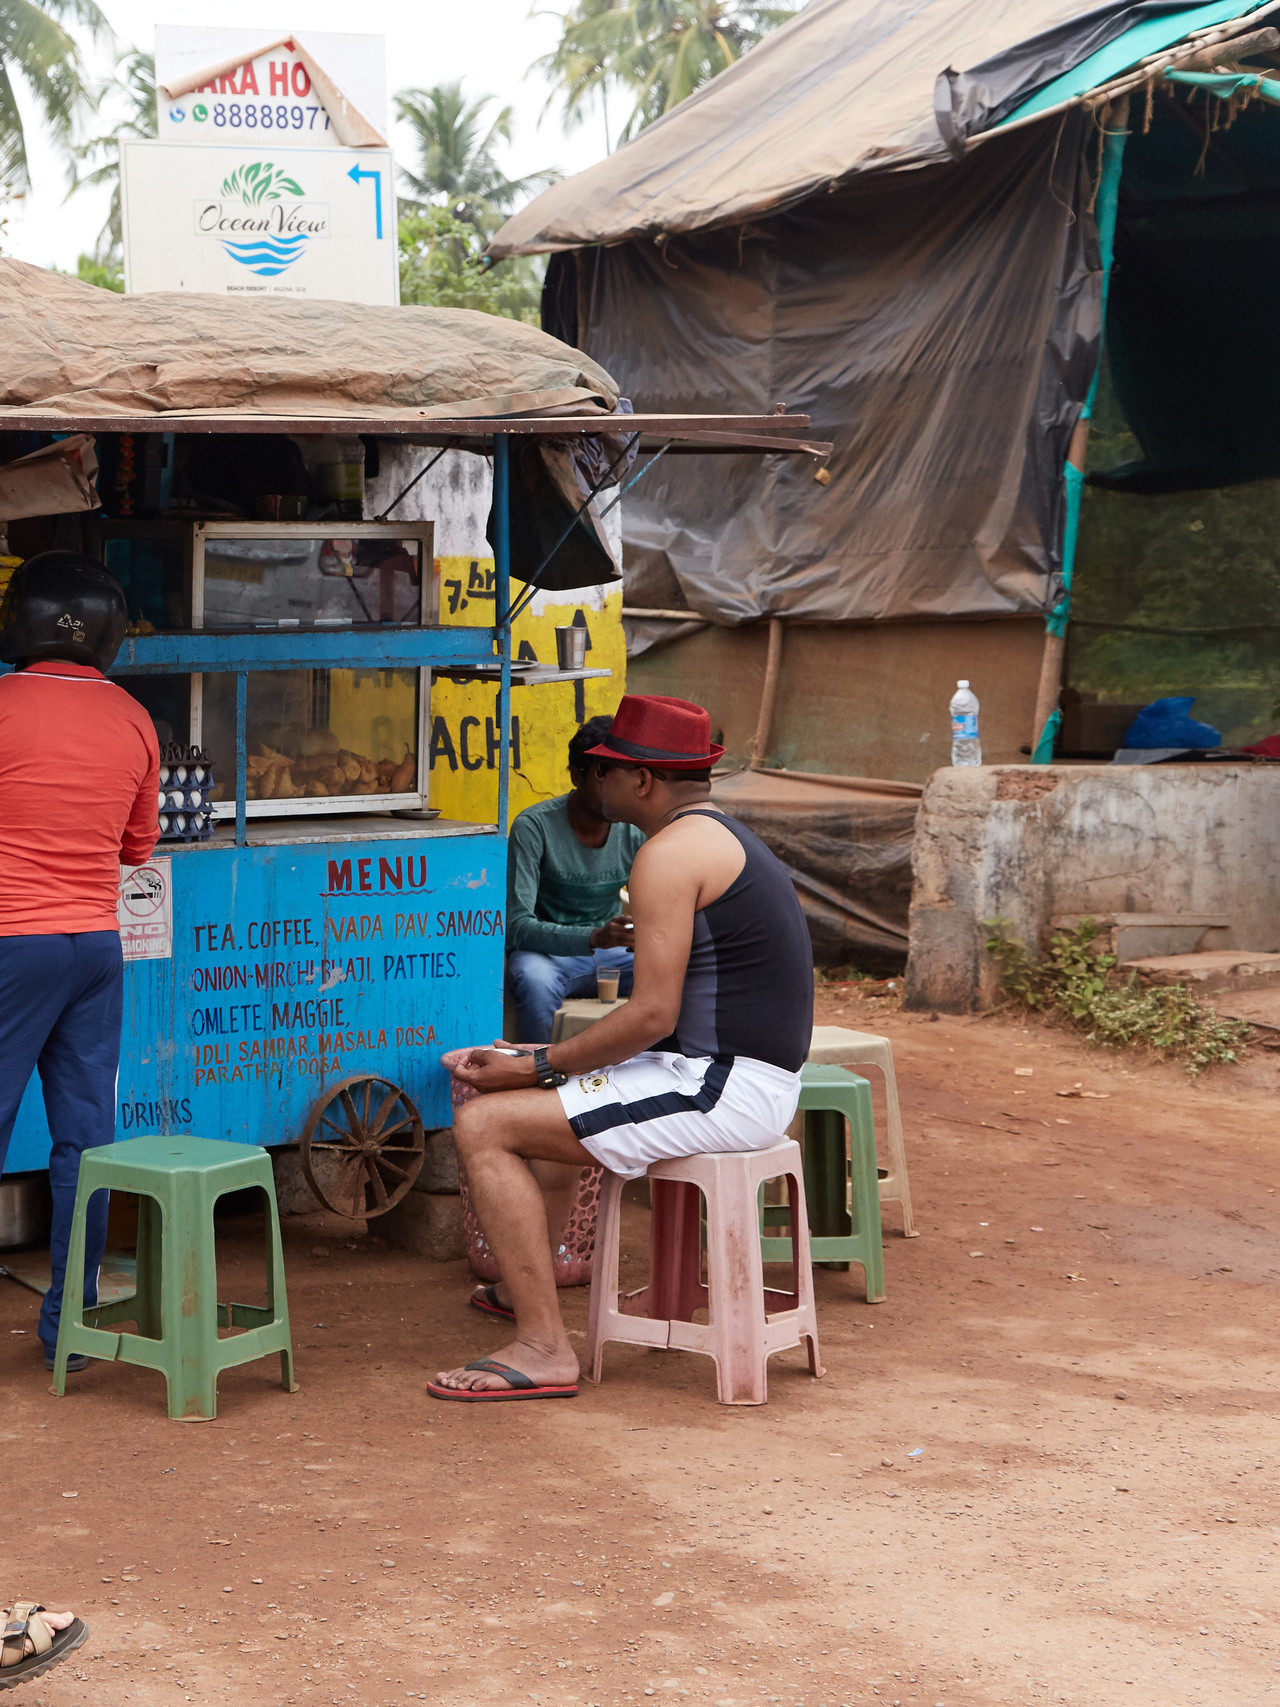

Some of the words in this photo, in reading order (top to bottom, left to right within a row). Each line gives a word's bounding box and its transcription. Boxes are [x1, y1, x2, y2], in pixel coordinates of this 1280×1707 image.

[328, 855, 427, 892] MENU
[121, 923, 166, 938] NO
[193, 923, 243, 952] TEA,
[248, 918, 320, 949] COFFEE,
[328, 914, 384, 943] VADA
[395, 912, 431, 940] PAV,
[436, 909, 504, 937] SAMOSA
[384, 952, 460, 980] PATTIES,
[192, 1004, 266, 1036] OMLETE,
[272, 998, 350, 1031] MAGGIE,
[195, 1043, 229, 1067] IDLI
[318, 1029, 388, 1054] MASALA
[298, 1056, 342, 1077] DOSA
[122, 1099, 193, 1129] DRINKS
